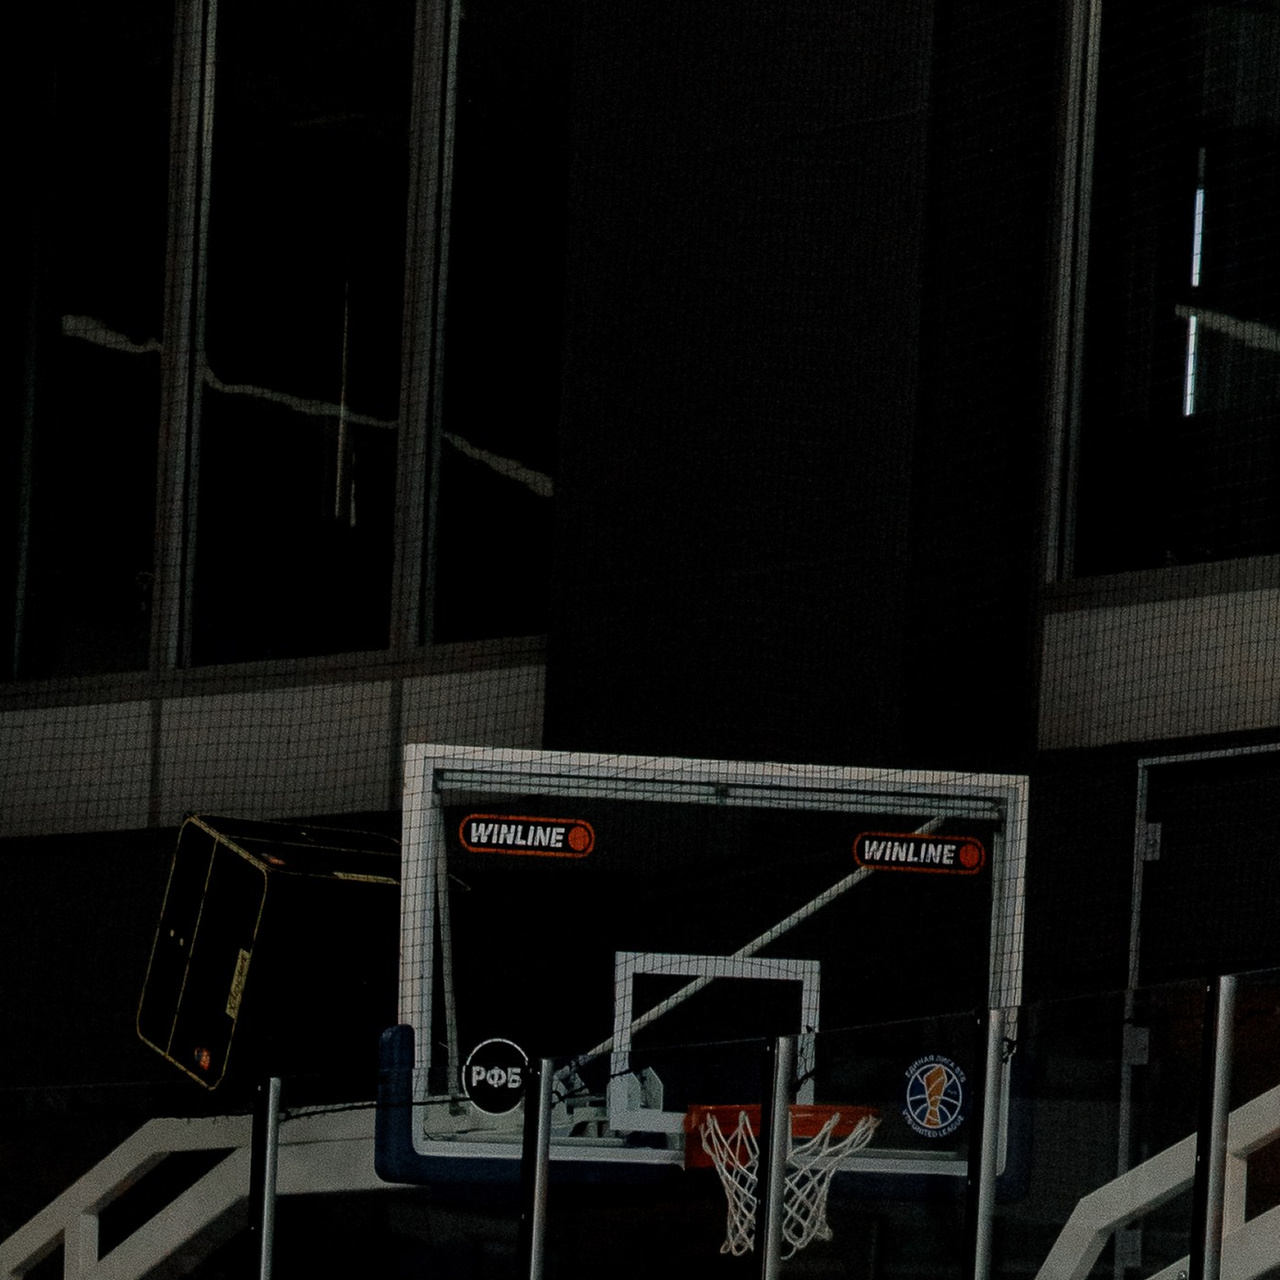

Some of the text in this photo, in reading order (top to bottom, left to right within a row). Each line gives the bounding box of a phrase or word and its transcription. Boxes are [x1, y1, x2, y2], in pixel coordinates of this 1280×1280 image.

[470, 822, 564, 848] WINLINE
[864, 838, 955, 865] WINLINE
[471, 1065, 522, 1089] РФБ
